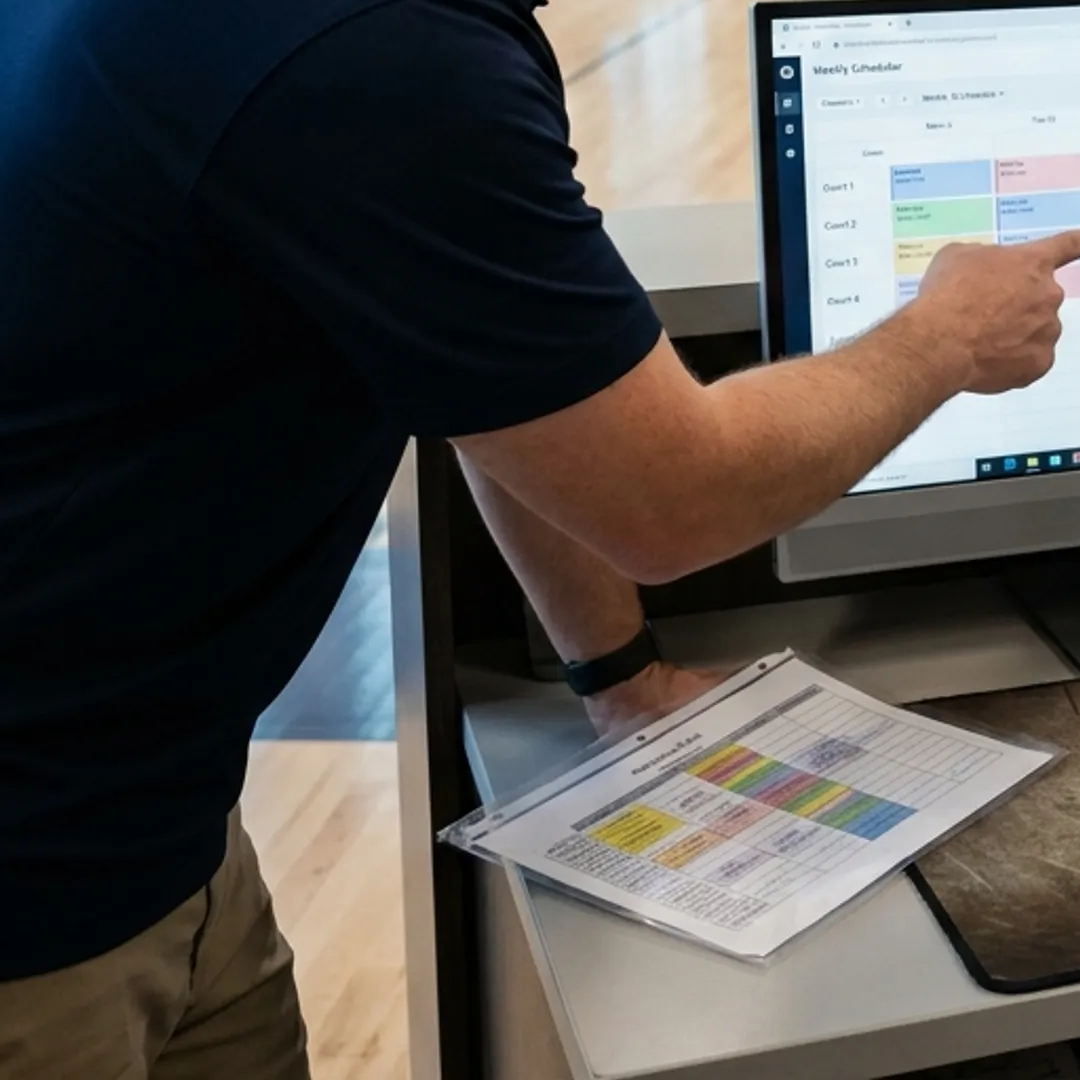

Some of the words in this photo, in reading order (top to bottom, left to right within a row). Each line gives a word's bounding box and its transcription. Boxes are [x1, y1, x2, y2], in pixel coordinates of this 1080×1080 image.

[823, 183, 848, 193] Court
[824, 221, 849, 231] Court
[825, 258, 850, 269] Court
